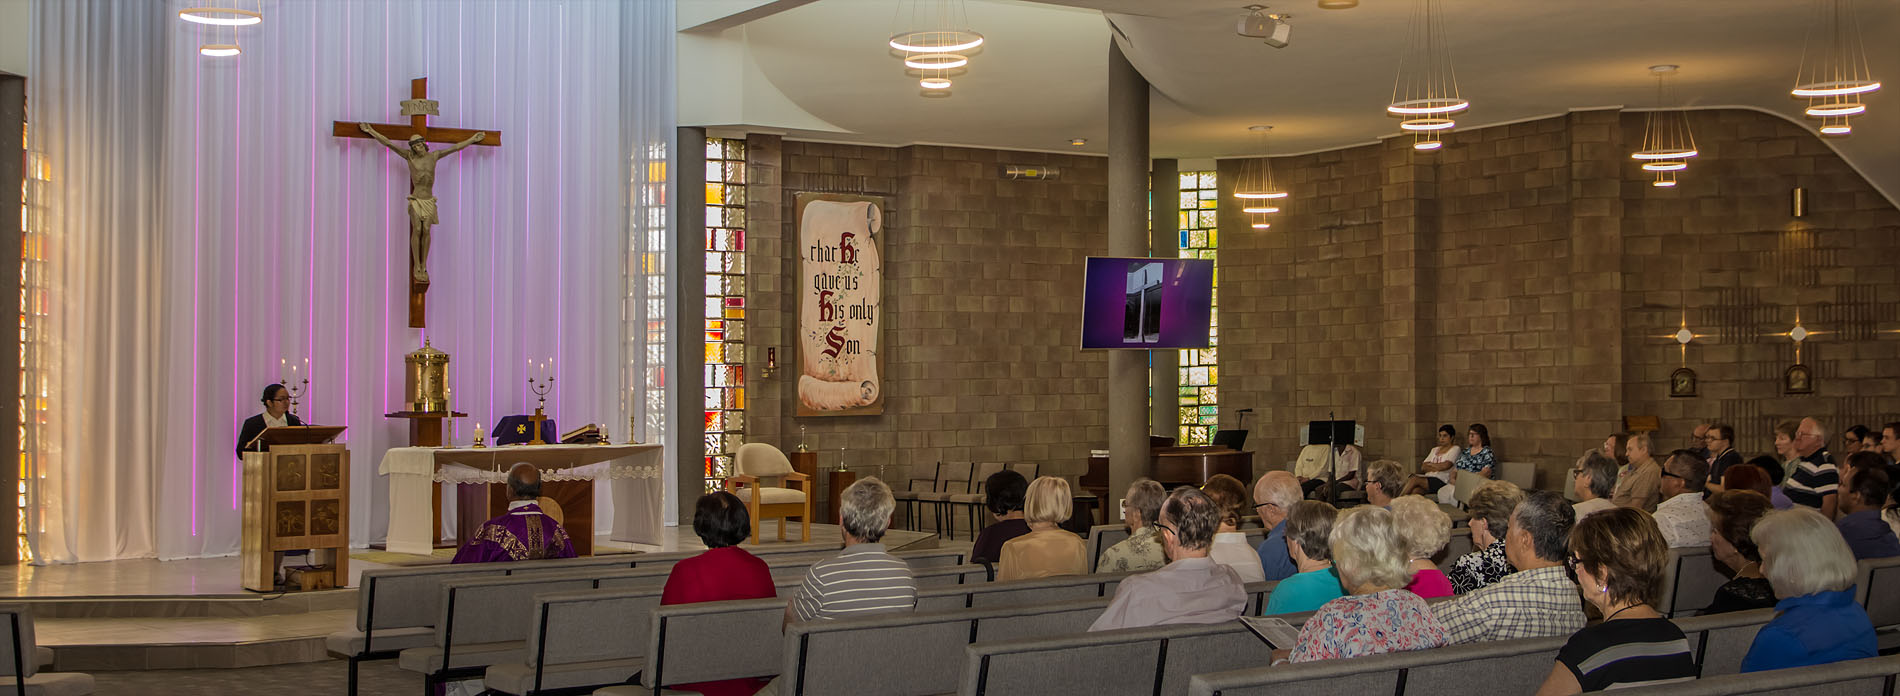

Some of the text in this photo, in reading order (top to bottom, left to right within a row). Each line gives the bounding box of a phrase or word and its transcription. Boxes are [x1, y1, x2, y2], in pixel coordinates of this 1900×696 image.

[810, 240, 838, 263] that
[814, 272, 858, 295] gave us
[818, 290, 875, 327] His only
[821, 325, 861, 359] Son
